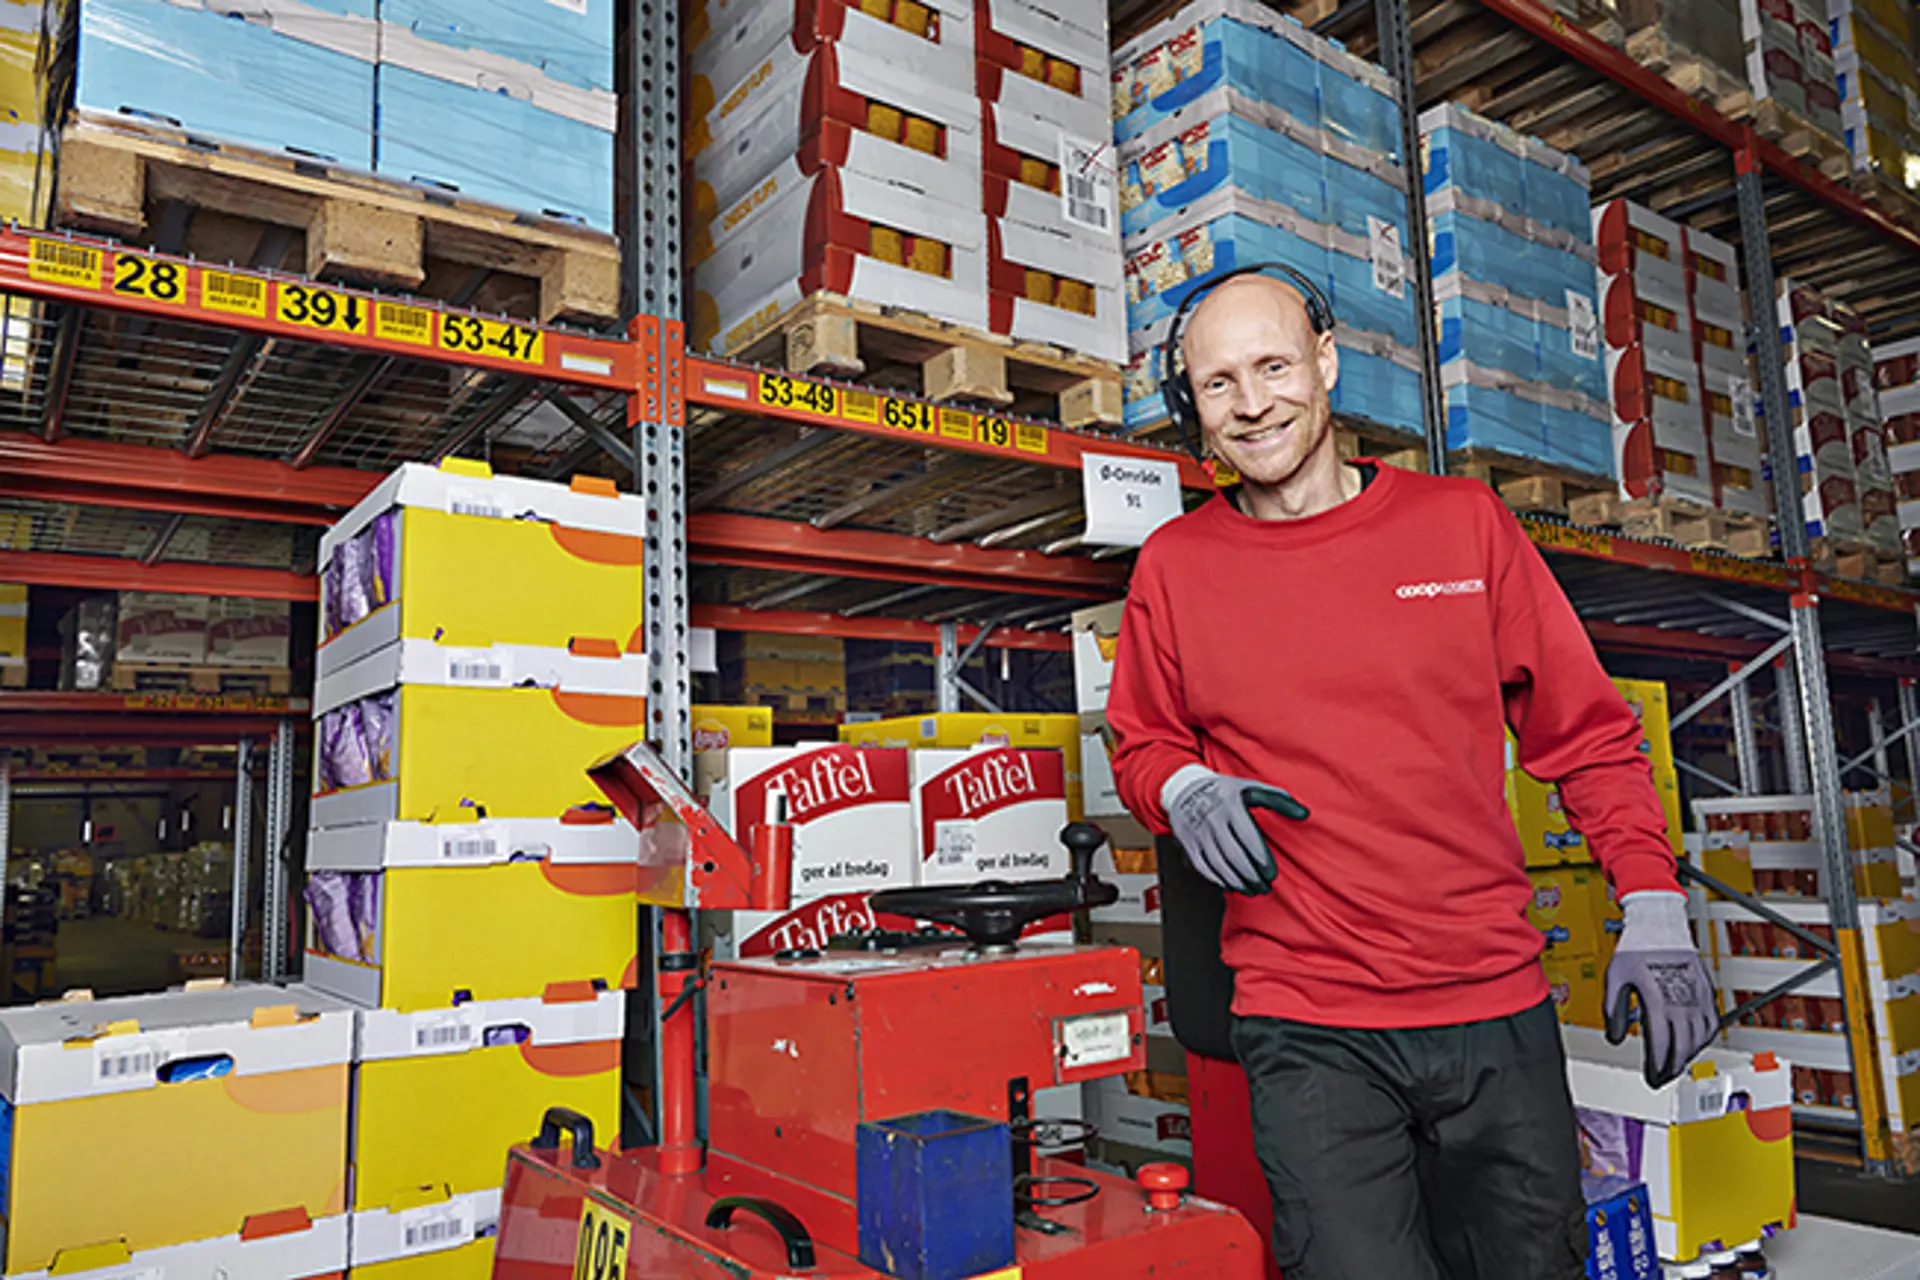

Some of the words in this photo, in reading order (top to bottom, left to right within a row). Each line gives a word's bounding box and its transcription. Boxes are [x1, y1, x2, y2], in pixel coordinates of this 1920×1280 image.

[114, 255, 178, 299] 28
[282, 286, 337, 325] 39
[443, 316, 539, 359] 53-47
[761, 374, 835, 413] 53-49
[884, 400, 917, 430] 65
[978, 416, 1008, 445] 19
[765, 751, 876, 818] Taffel
[944, 752, 1037, 816] Taffel
